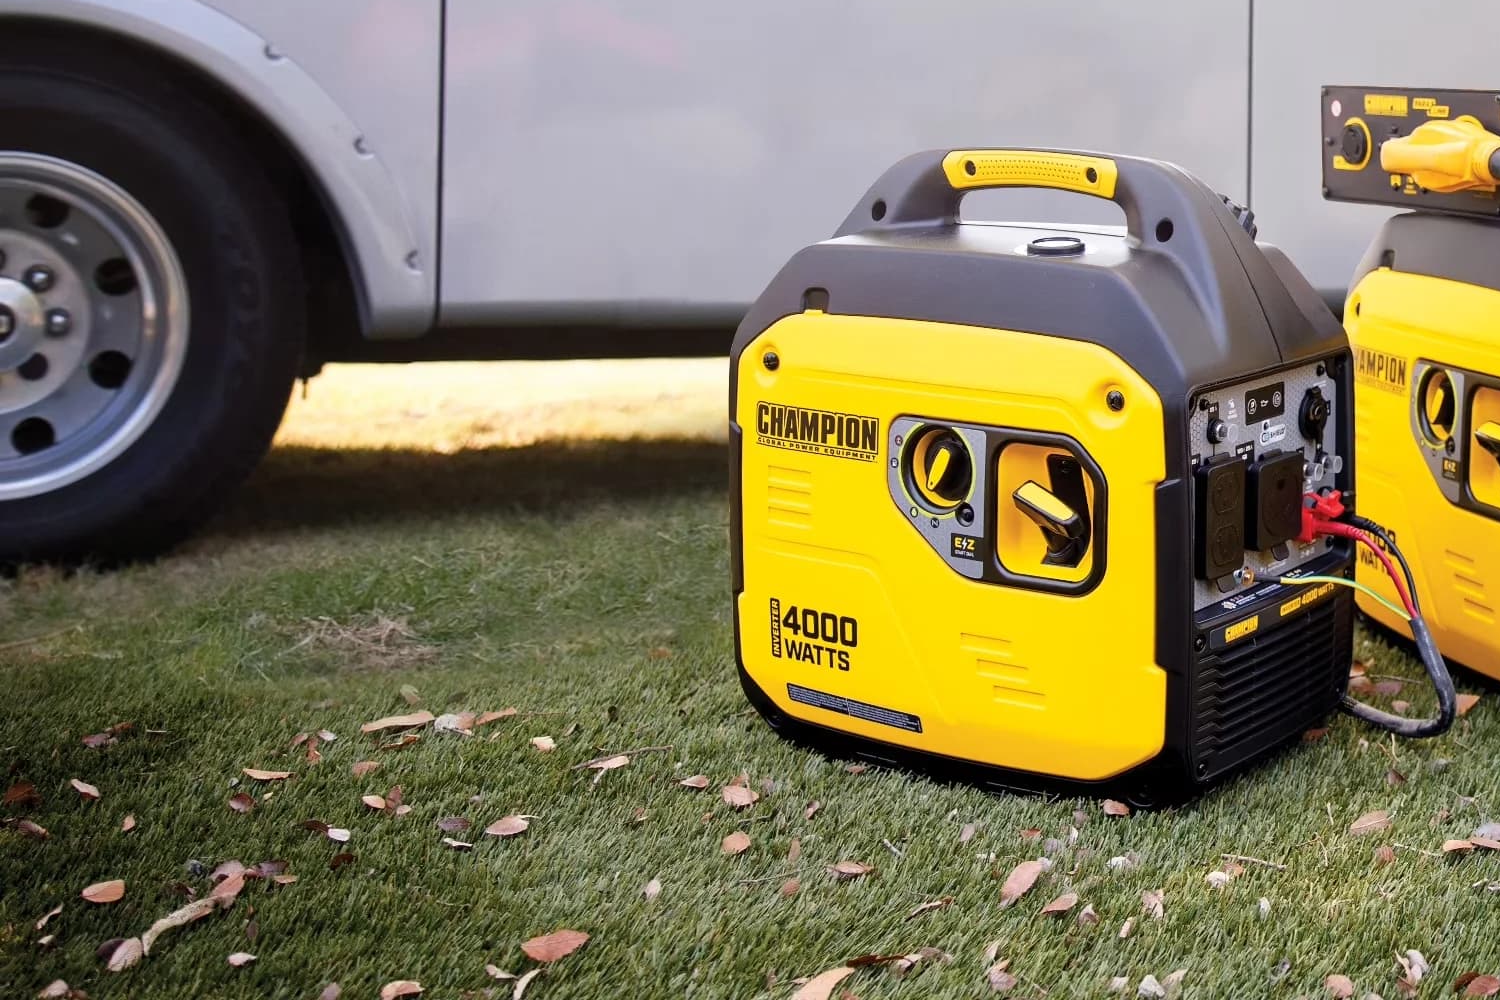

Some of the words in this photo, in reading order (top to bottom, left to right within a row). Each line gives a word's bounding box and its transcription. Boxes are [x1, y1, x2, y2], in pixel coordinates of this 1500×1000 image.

[1353, 347, 1407, 386] AMPION
[757, 402, 878, 453] CHAMPION
[789, 442, 820, 453] POWER
[823, 447, 877, 461] EQUIPMENT
[771, 599, 782, 658] INVERTER
[782, 606, 858, 647] 4000
[784, 639, 850, 671] WATTS
